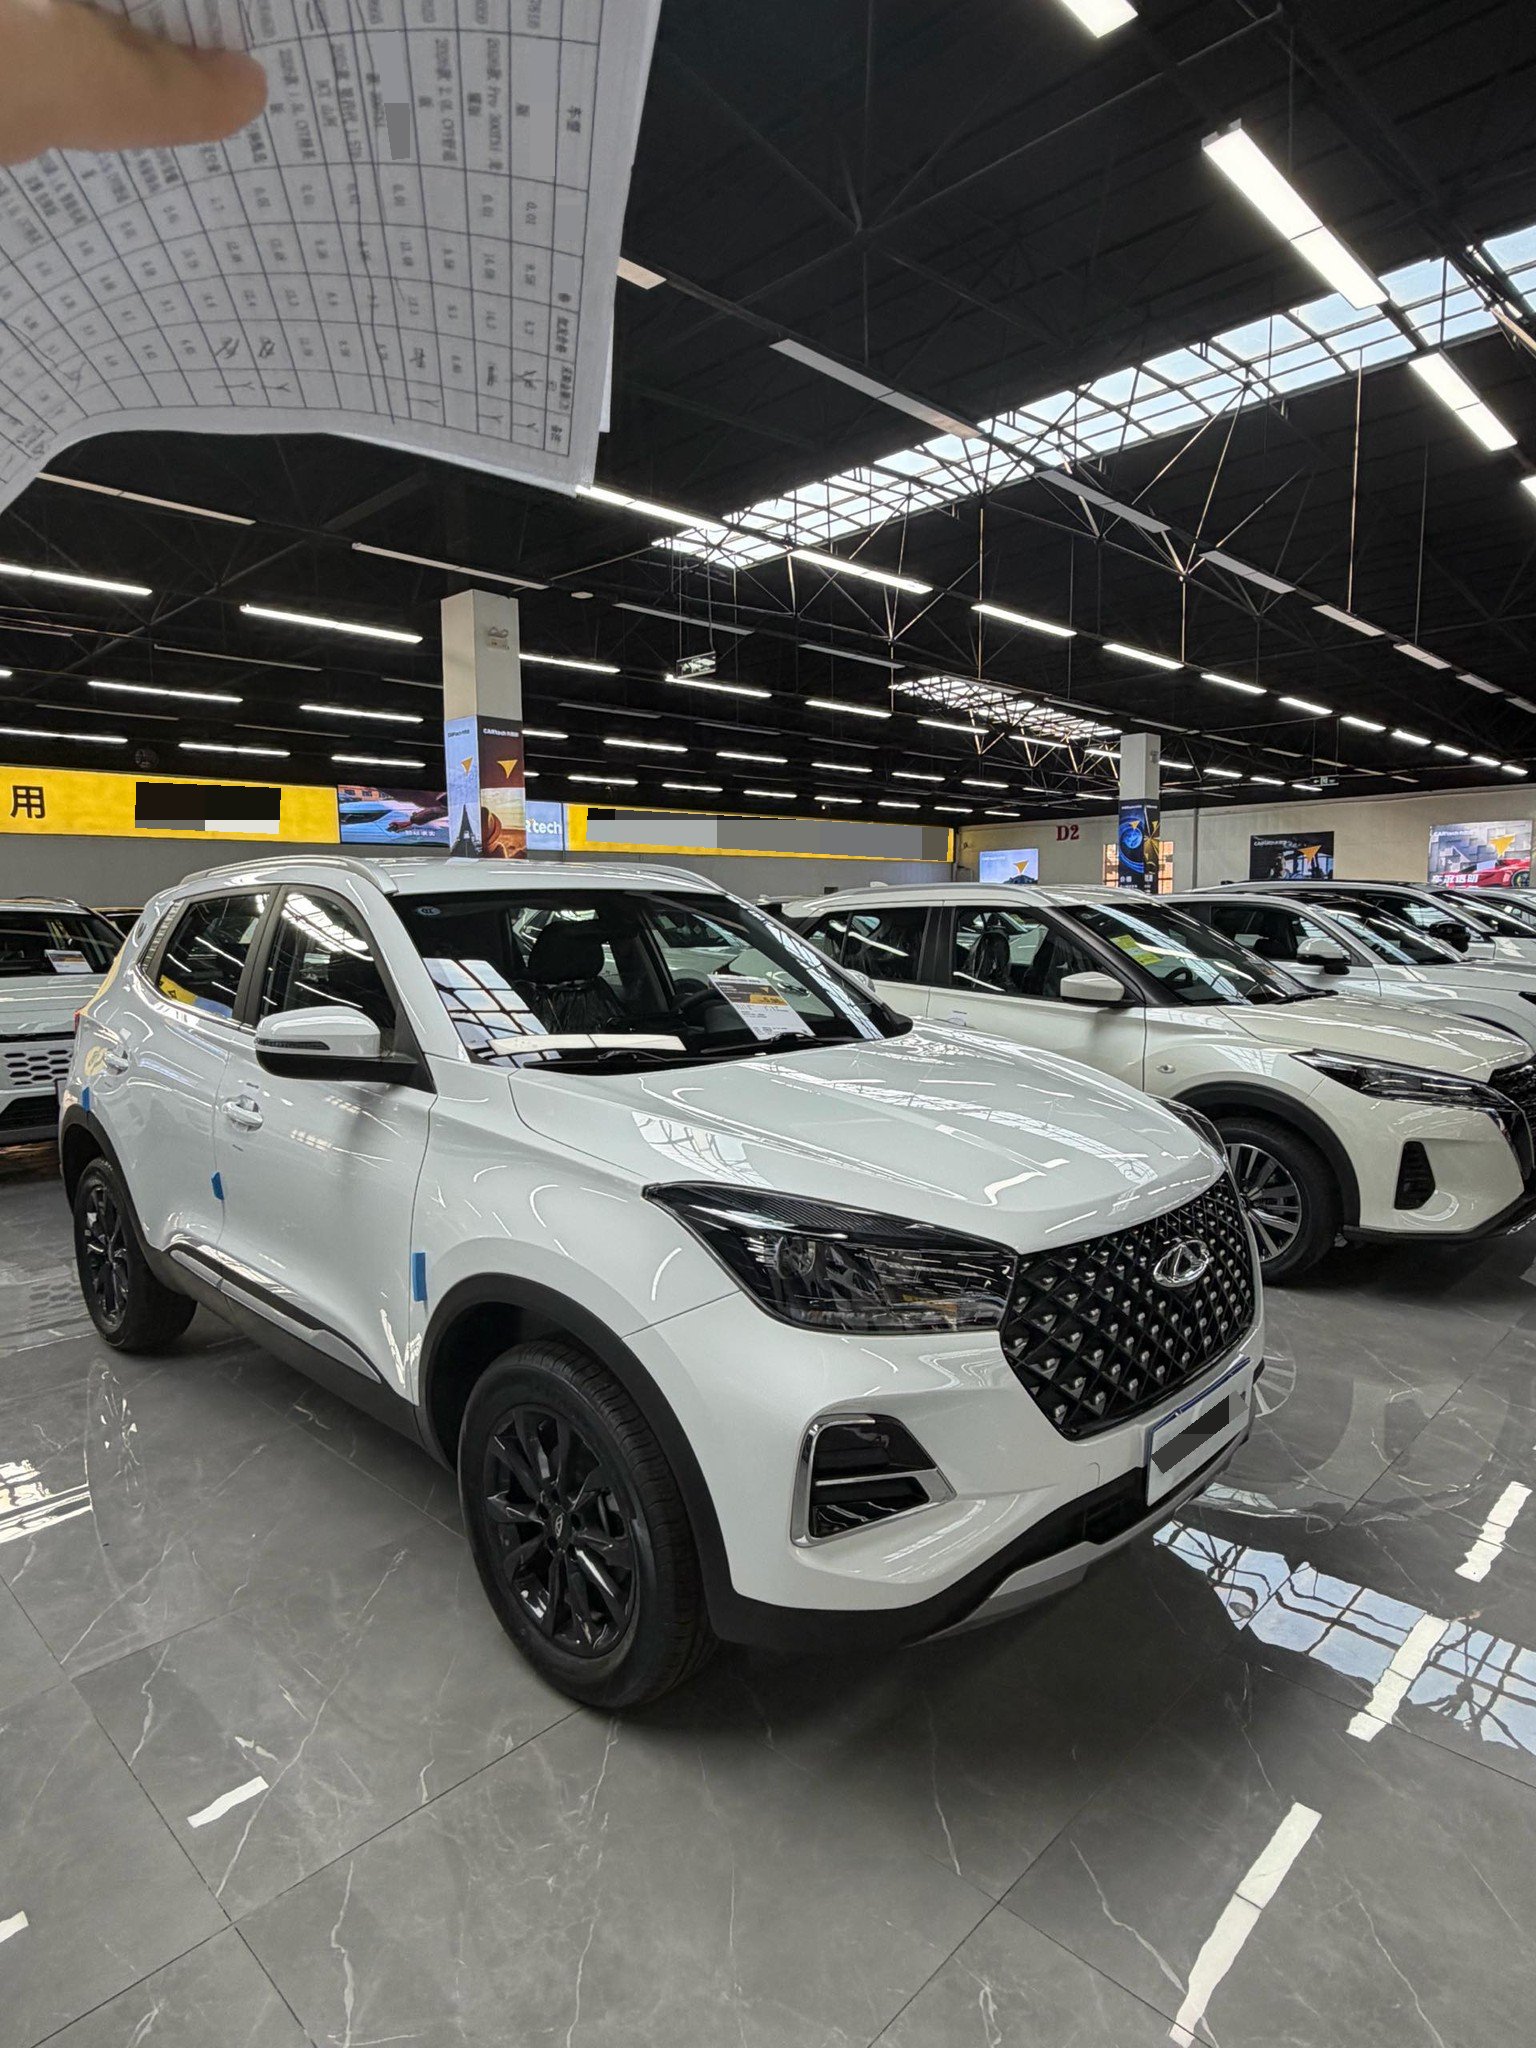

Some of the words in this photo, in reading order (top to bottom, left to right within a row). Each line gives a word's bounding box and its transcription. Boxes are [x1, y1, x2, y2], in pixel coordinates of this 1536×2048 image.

[524, 201, 538, 226] 0.01
[10, 785, 46, 819] 用
[1056, 824, 1080, 841] D2
